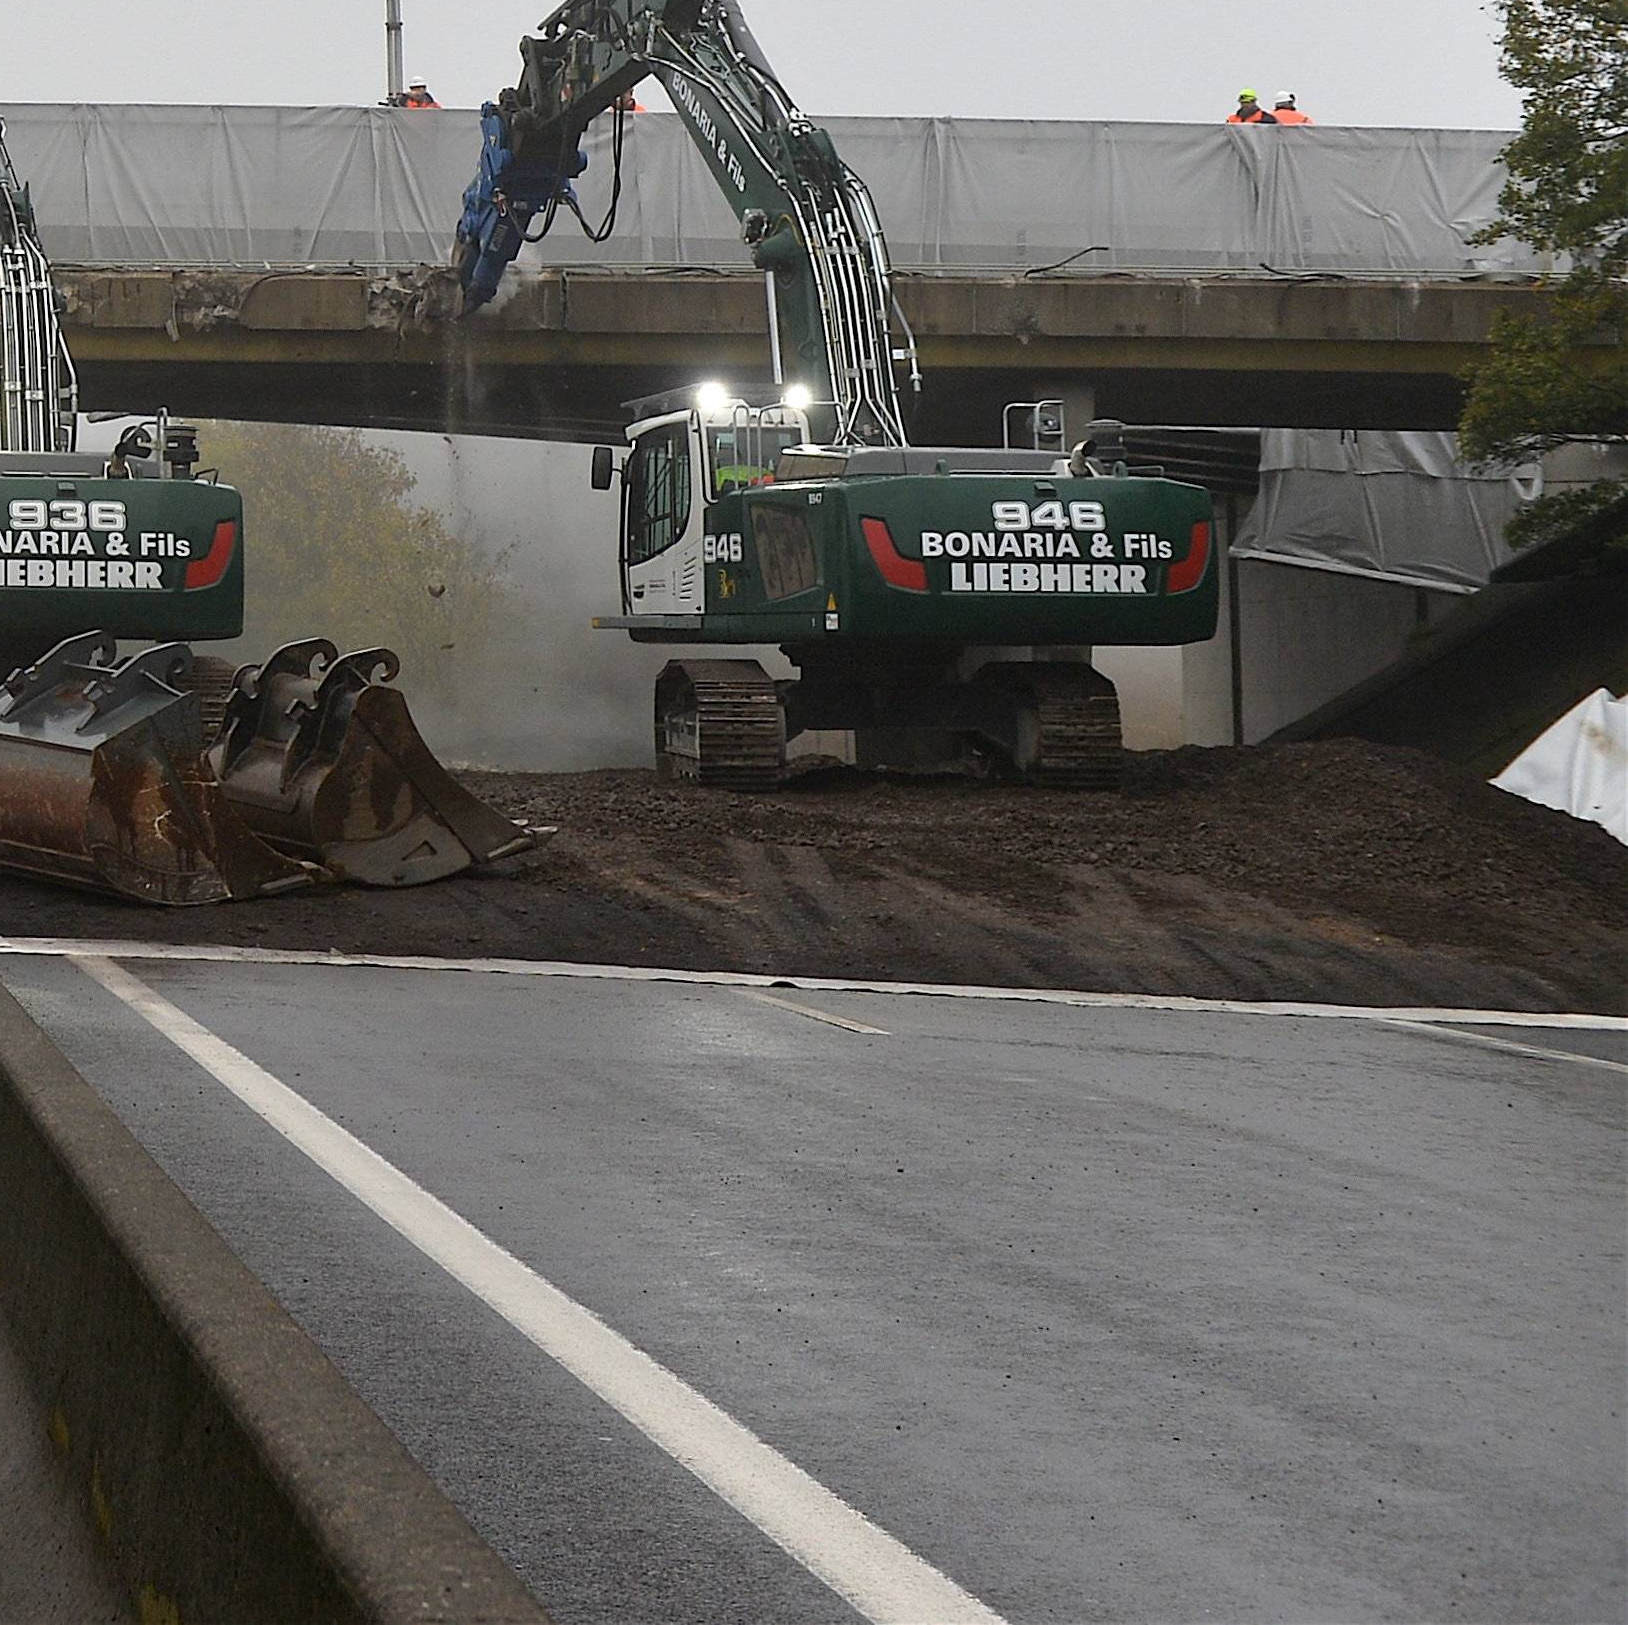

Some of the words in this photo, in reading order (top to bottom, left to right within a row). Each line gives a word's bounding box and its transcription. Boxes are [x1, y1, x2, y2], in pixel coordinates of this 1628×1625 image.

[672, 72, 717, 149] BONARIA
[717, 139, 727, 165] &
[727, 153, 746, 192] Fils
[8, 499, 127, 531] 936
[992, 501, 1106, 531] 946
[105, 532, 130, 556] &
[140, 533, 191, 557] Fils
[704, 533, 742, 563] 946
[921, 532, 1081, 558] BONARIA
[1089, 533, 1115, 558] &
[1123, 534, 1173, 558] Fils
[950, 563, 1147, 593] LIEBHERR
